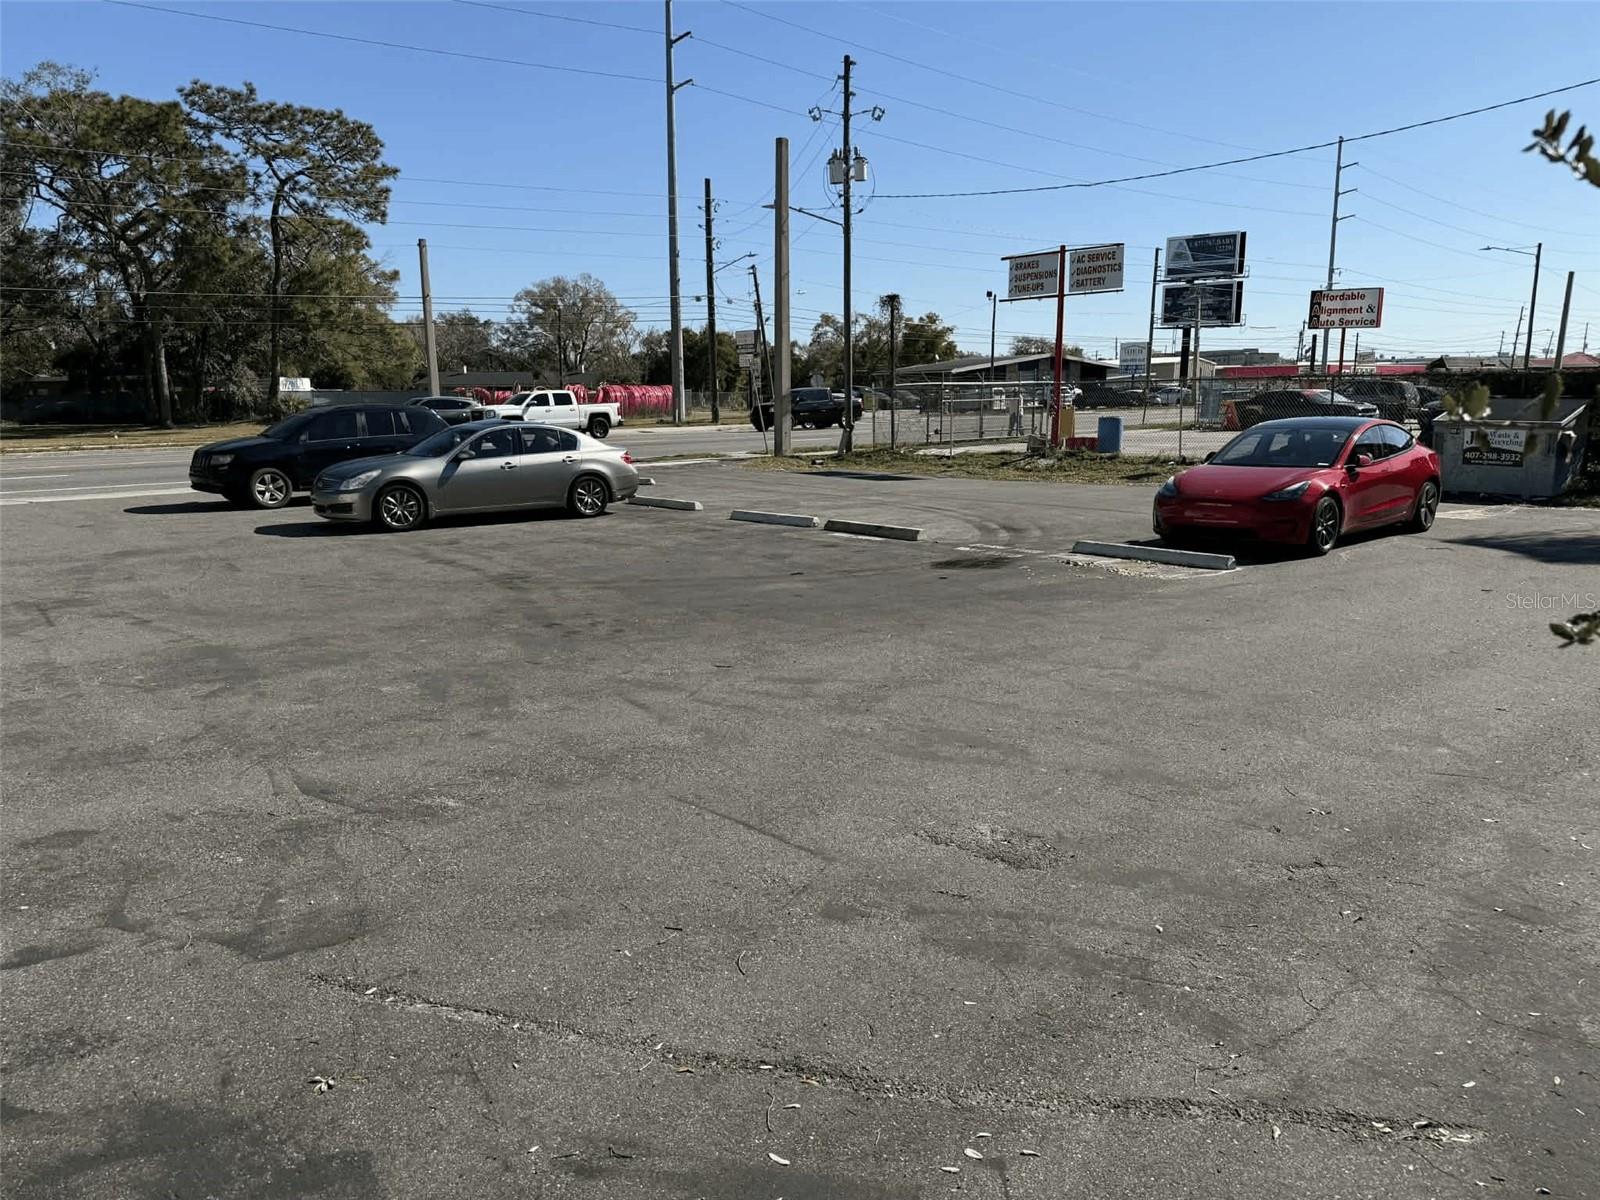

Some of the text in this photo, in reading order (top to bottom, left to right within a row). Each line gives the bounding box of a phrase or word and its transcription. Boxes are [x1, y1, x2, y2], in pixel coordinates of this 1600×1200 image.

[1076, 251, 1116, 264] AC SERVICE
[1014, 260, 1039, 271] BRAKES
[1076, 262, 1121, 276] DIAGNOSTICS
[1014, 269, 1057, 282] SUSPENSIONS
[1013, 282, 1044, 294] TUNE-UPS
[1075, 277, 1106, 288] BATTERY
[1313, 292, 1366, 303] Affordable
[1312, 304, 1376, 317] Alignment &
[1311, 317, 1375, 327] Auto Service
